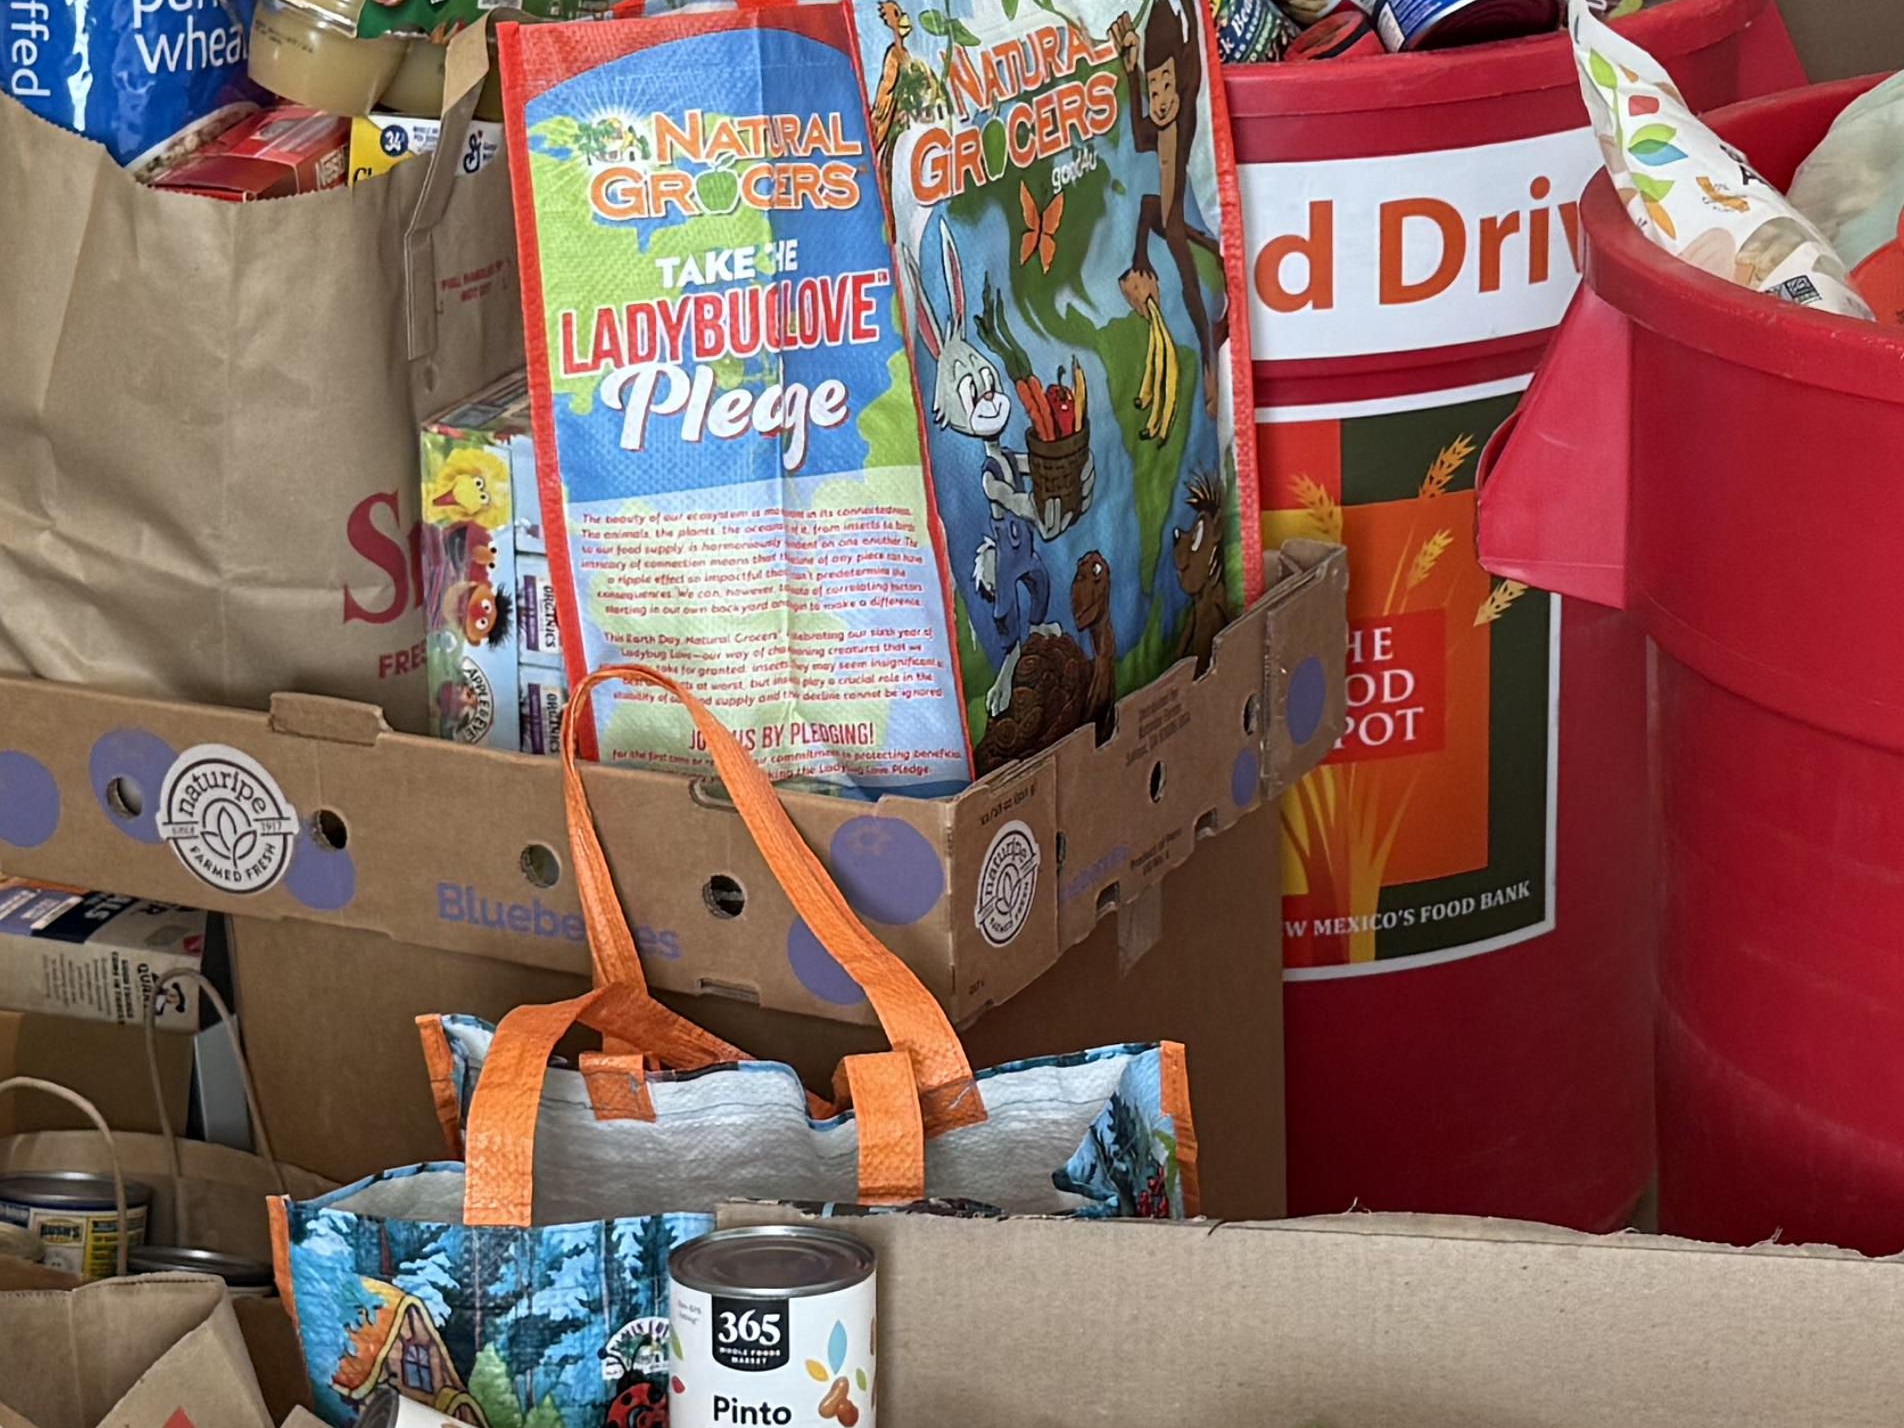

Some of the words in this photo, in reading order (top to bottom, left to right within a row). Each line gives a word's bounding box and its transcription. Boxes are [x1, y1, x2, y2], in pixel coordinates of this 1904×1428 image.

[134, 15, 248, 75] whea
[384, 132, 404, 152] 34
[652, 109, 863, 166] NATURAL
[655, 245, 757, 289] TAKE
[764, 238, 799, 272] HE
[1378, 174, 1583, 309] Dri
[1345, 626, 1393, 664] HE
[1345, 668, 1415, 708] OD
[763, 724, 784, 748] BY
[791, 722, 875, 745] PLEDGING!
[1332, 706, 1425, 750] POT
[178, 770, 267, 818] naturipe
[190, 845, 243, 883] FARMED
[246, 843, 276, 881] FRESH
[435, 882, 681, 961] Bluebees
[1313, 907, 1416, 937] MEXICO'S
[1420, 897, 1476, 924] FOOD
[1480, 880, 1531, 912] BANK
[718, 1310, 780, 1345] 365
[713, 1396, 792, 1426] Pinto
